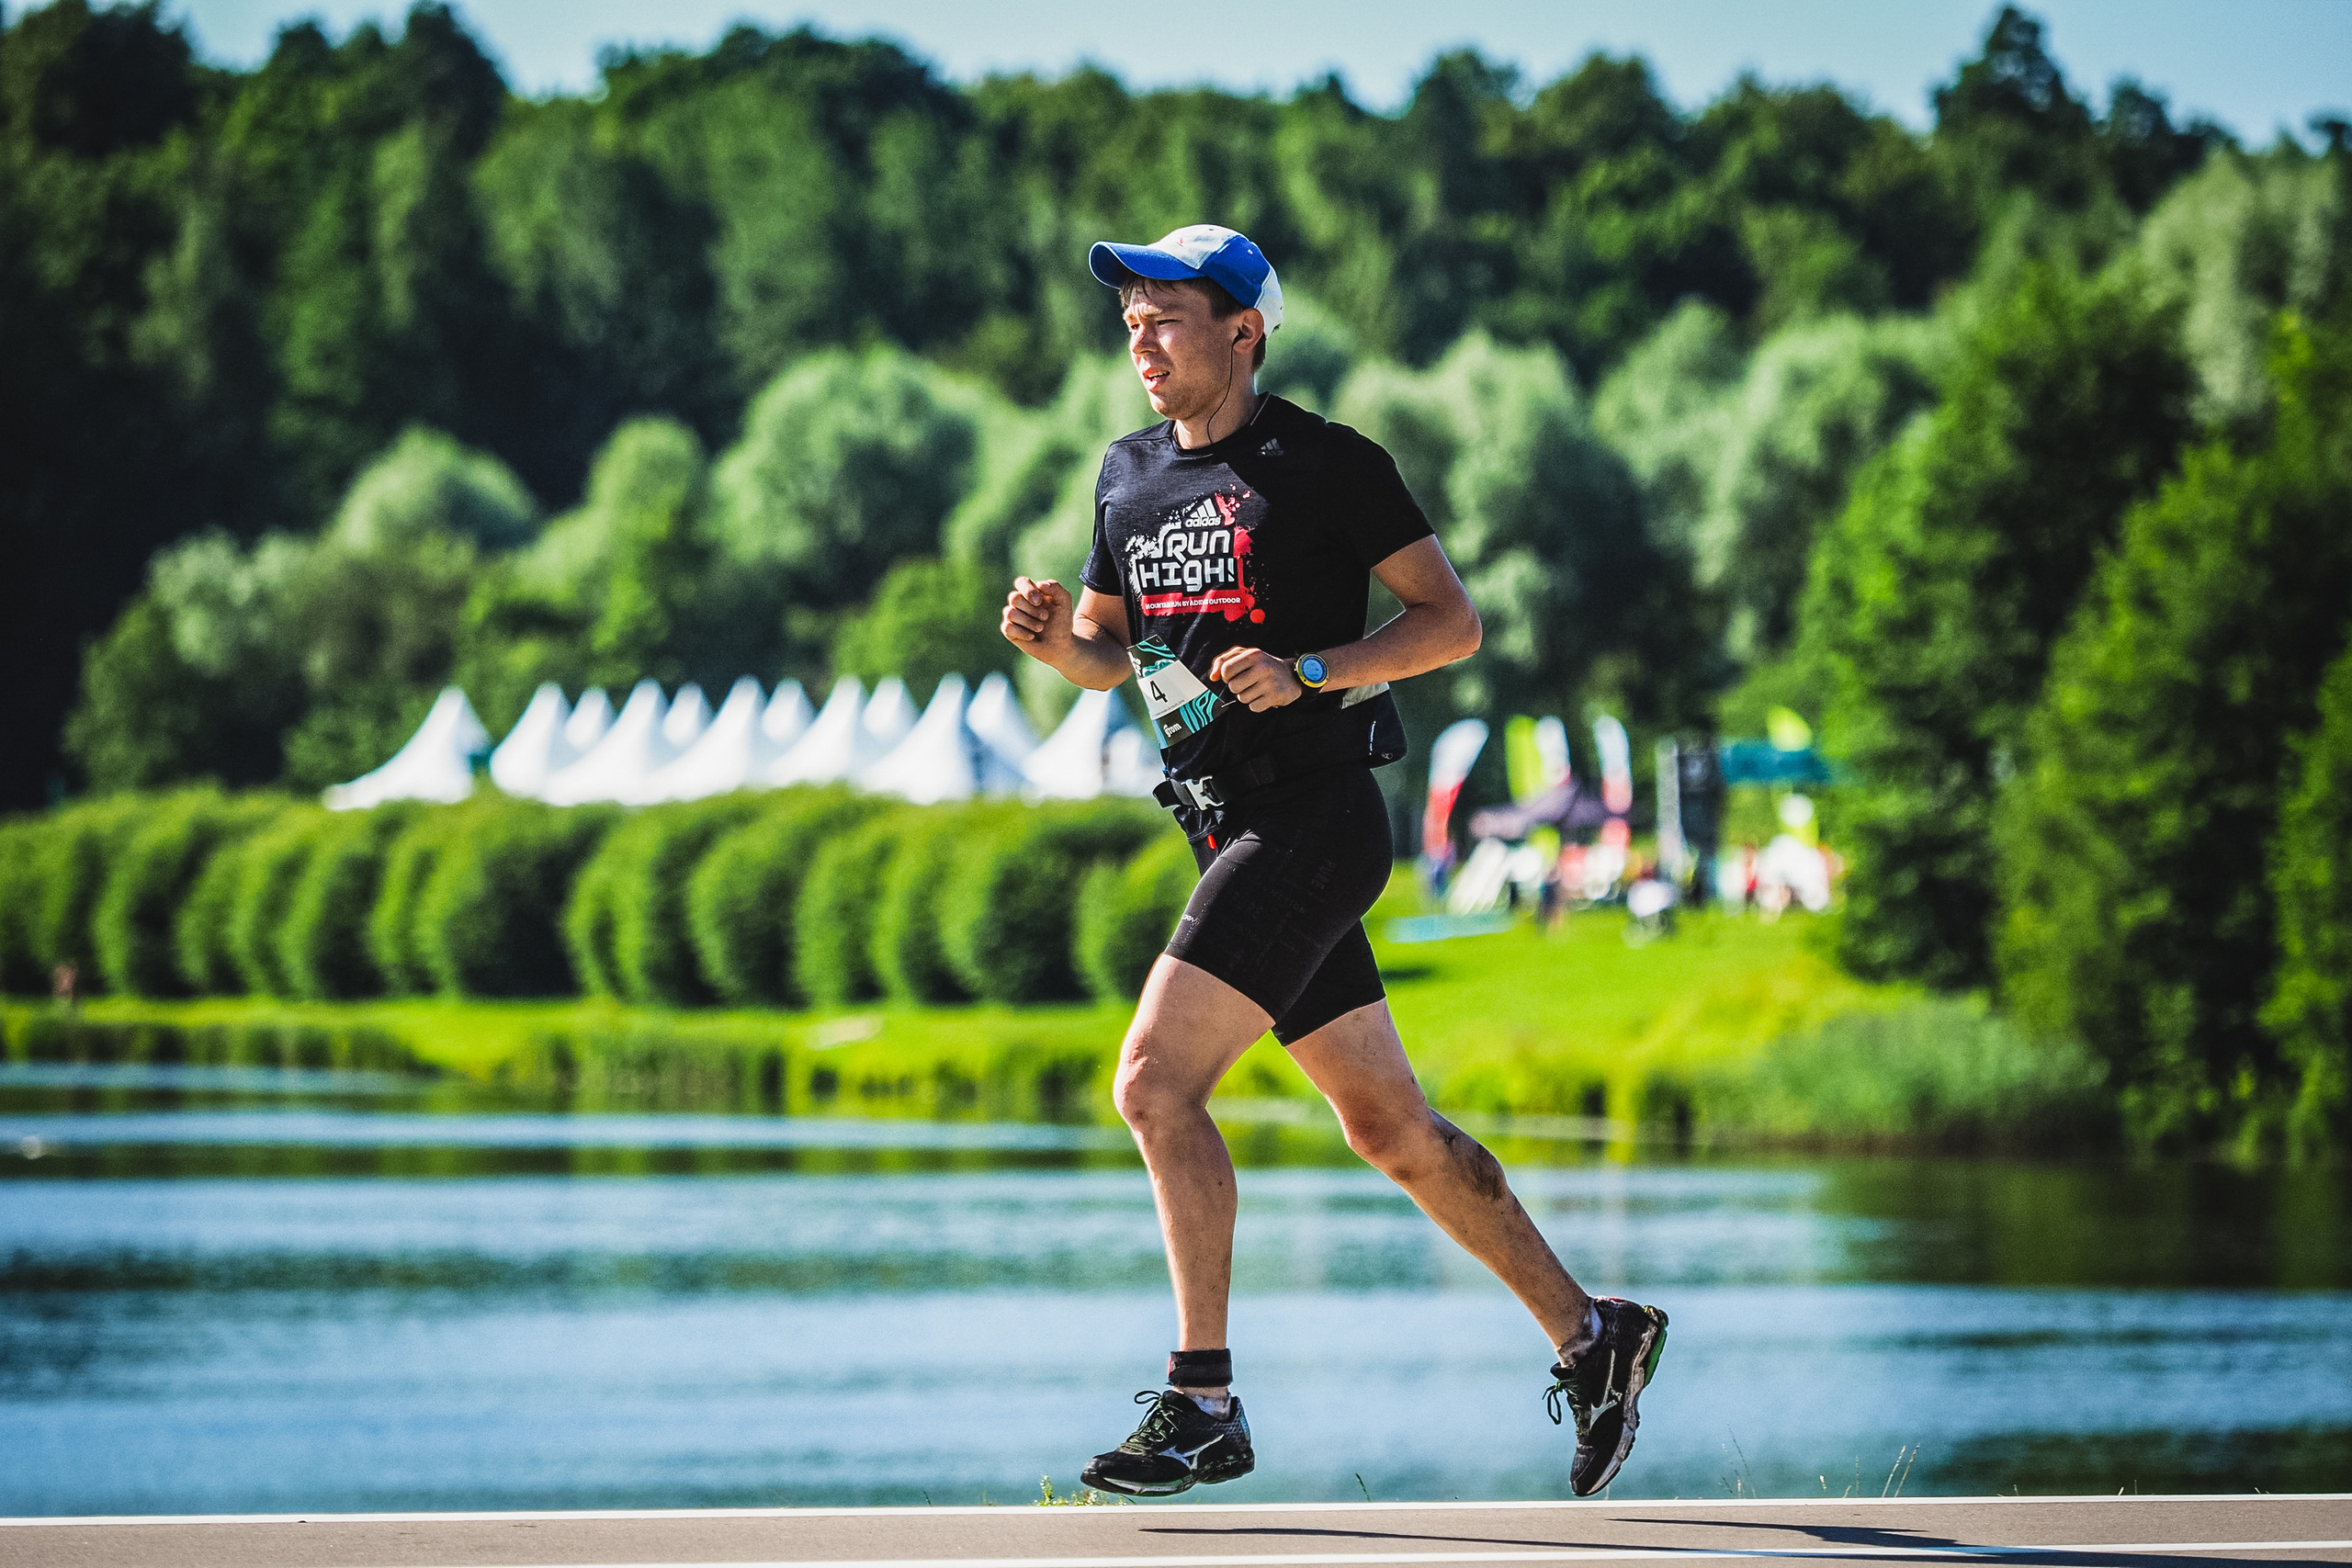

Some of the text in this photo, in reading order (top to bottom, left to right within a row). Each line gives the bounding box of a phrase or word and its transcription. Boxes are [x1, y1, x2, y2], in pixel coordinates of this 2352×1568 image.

[1185, 516, 1221, 528] adidas
[1190, 598, 1208, 606] ADID
[1208, 597, 1241, 605] OUTDOOR
[1149, 680, 1168, 703] 4
